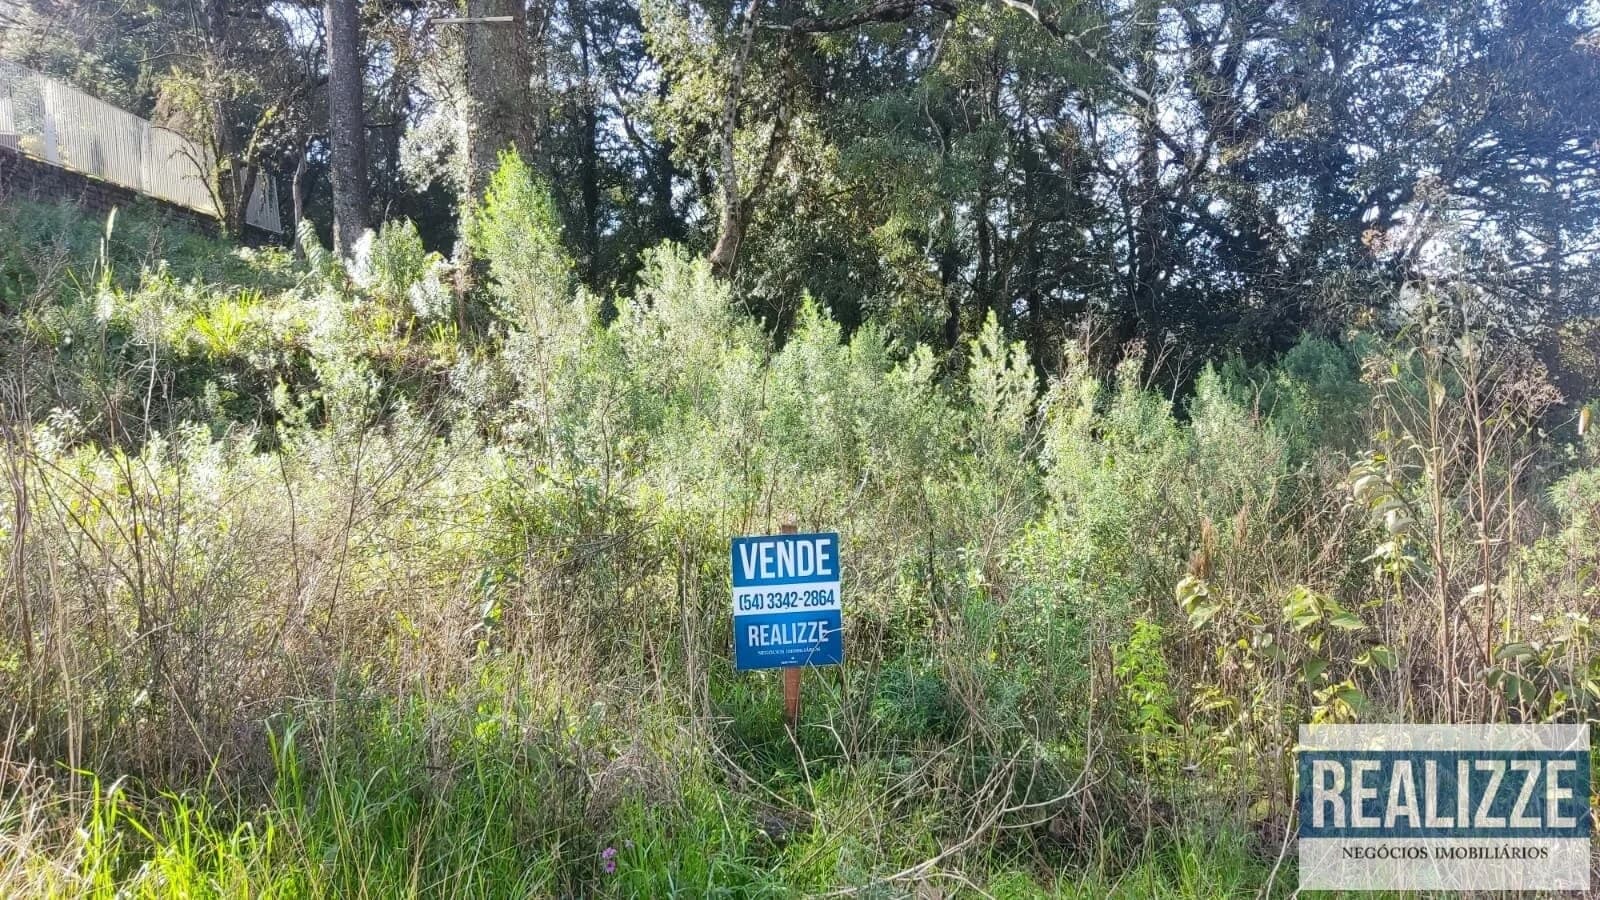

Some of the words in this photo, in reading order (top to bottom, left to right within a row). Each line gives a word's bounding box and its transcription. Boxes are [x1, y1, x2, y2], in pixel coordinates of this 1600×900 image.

[739, 539, 832, 580] VENDE
[739, 594, 764, 611] (54)
[767, 589, 835, 610] 3342-2864
[748, 620, 829, 647] REALIZZE
